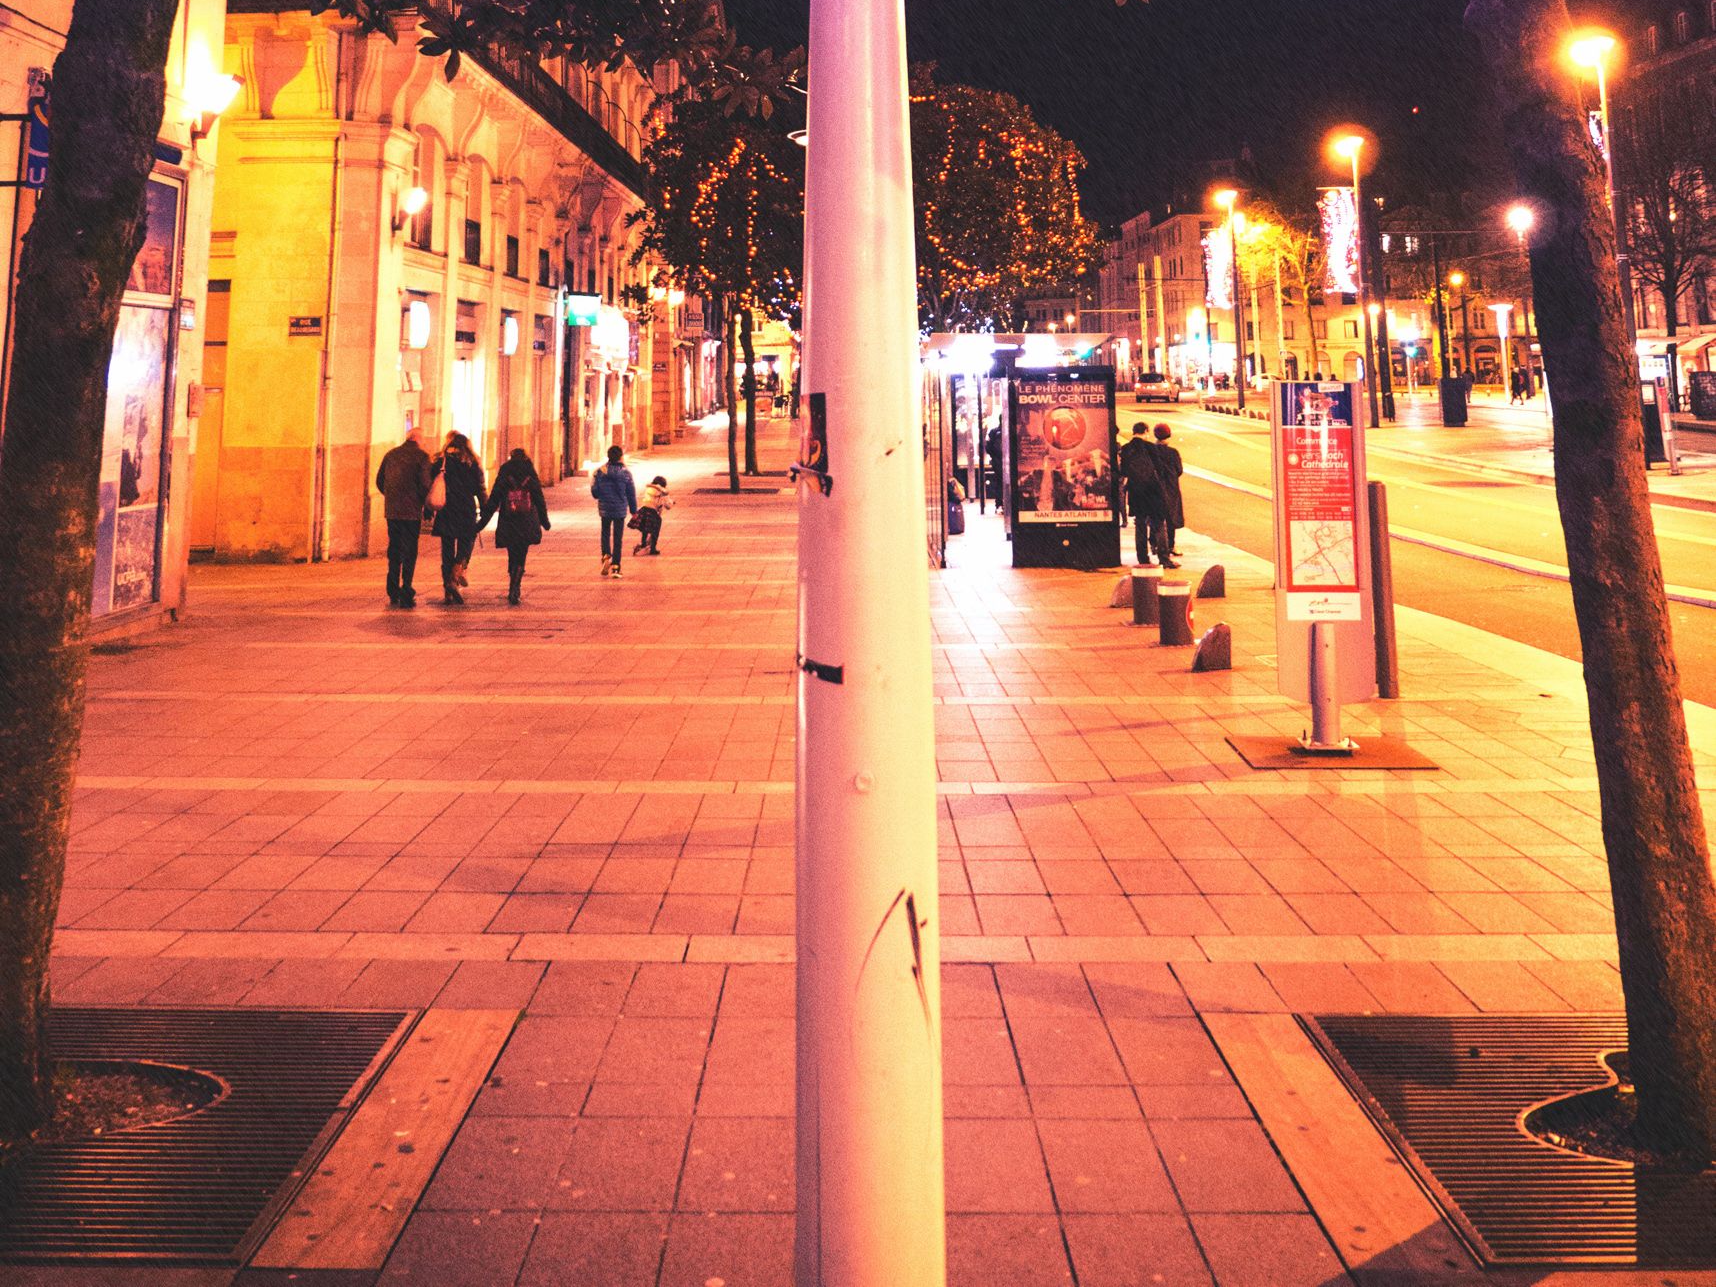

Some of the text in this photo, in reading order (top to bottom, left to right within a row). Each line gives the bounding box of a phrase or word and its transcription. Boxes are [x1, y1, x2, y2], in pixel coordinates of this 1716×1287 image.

[1019, 383, 1105, 393] LE PHÉNOMÈNE
[1058, 394, 1106, 403] CENTER
[1296, 437, 1338, 445] Commce
[1323, 451, 1344, 459] och
